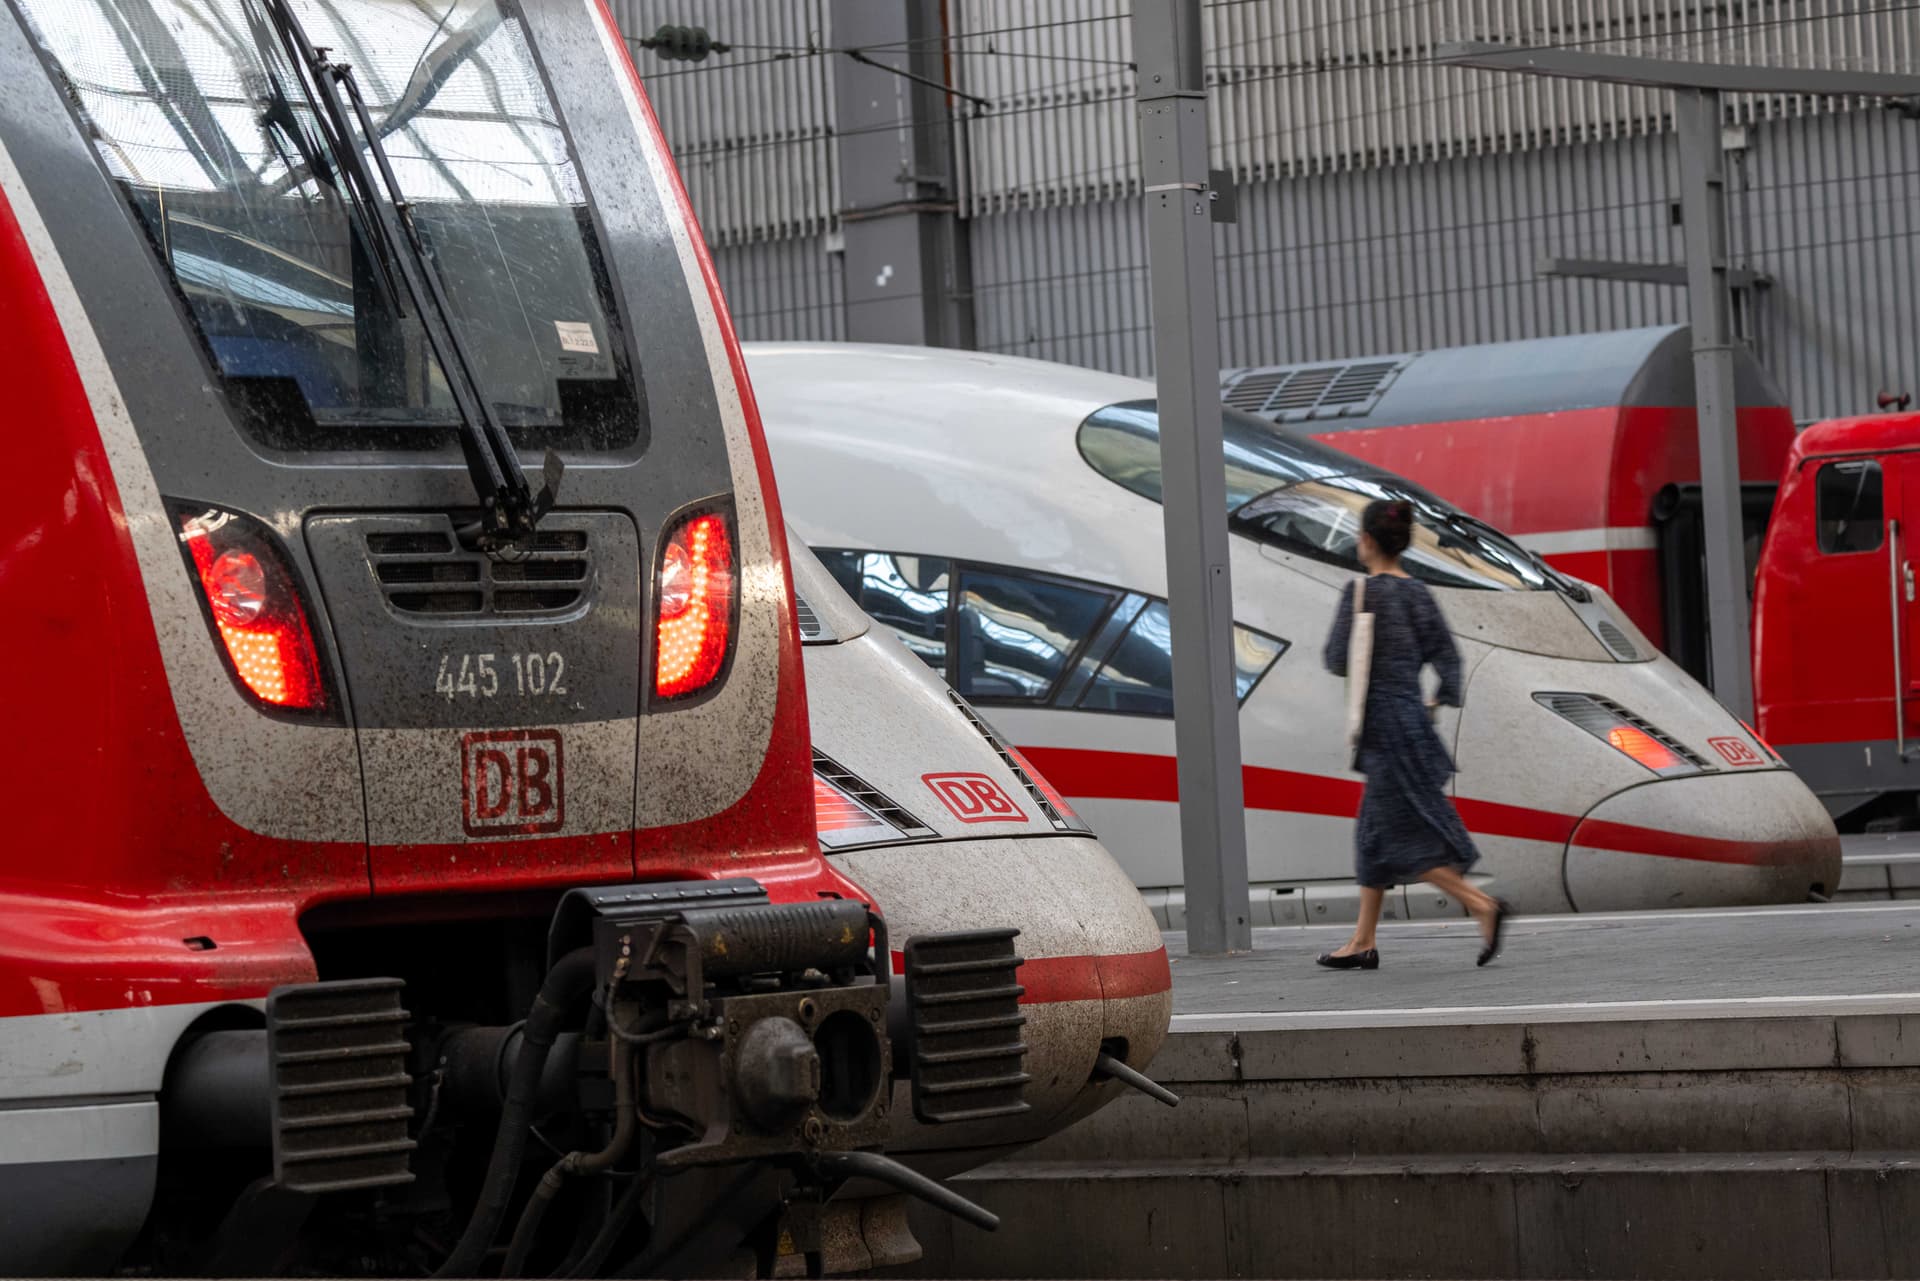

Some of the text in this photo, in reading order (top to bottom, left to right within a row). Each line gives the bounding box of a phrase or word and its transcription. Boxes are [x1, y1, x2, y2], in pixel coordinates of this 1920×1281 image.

[436, 652, 567, 699] 445 102
[1718, 741, 1756, 761] DB
[475, 747, 553, 819] DB
[937, 780, 1012, 814] DB
